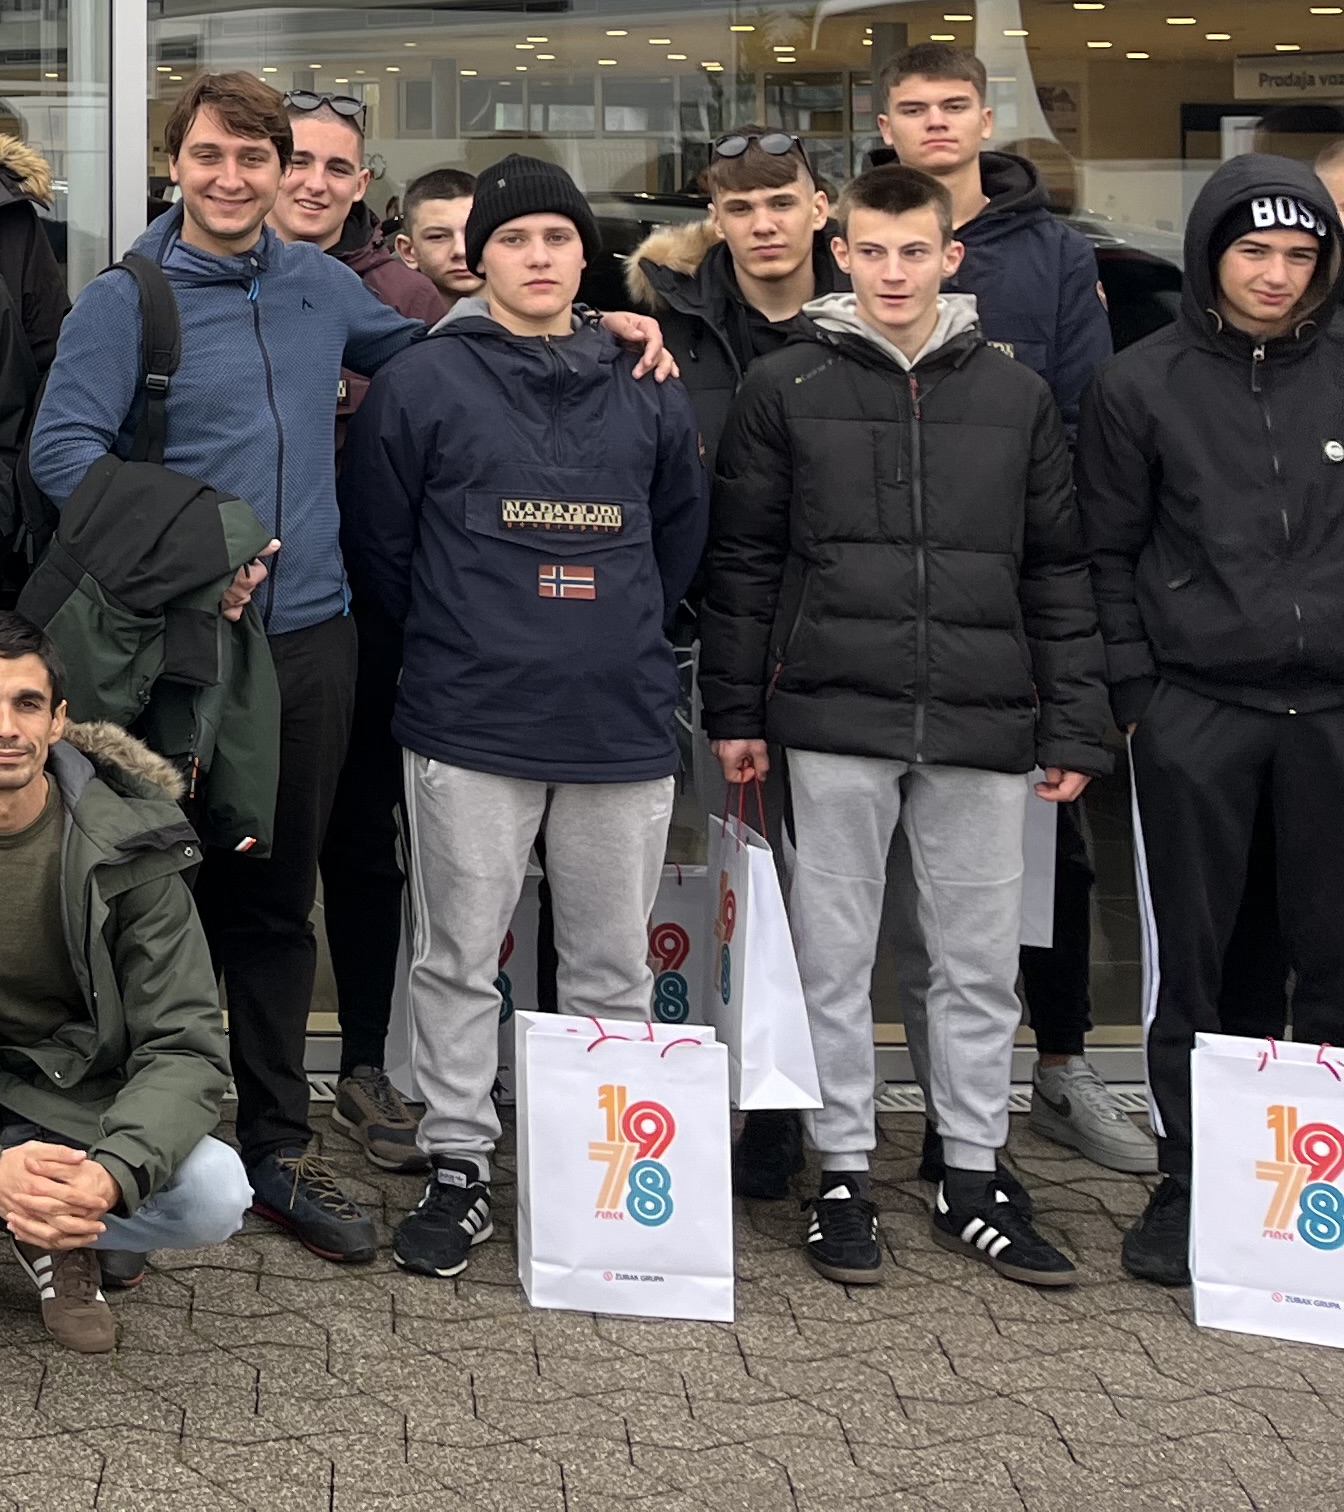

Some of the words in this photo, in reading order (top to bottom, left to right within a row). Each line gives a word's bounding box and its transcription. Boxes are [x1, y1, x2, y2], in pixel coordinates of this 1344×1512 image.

[1258, 72, 1316, 90] Prodaja
[505, 500, 620, 524] NAPAPIJRI
[647, 922, 690, 973] 9
[647, 957, 690, 1023] 8
